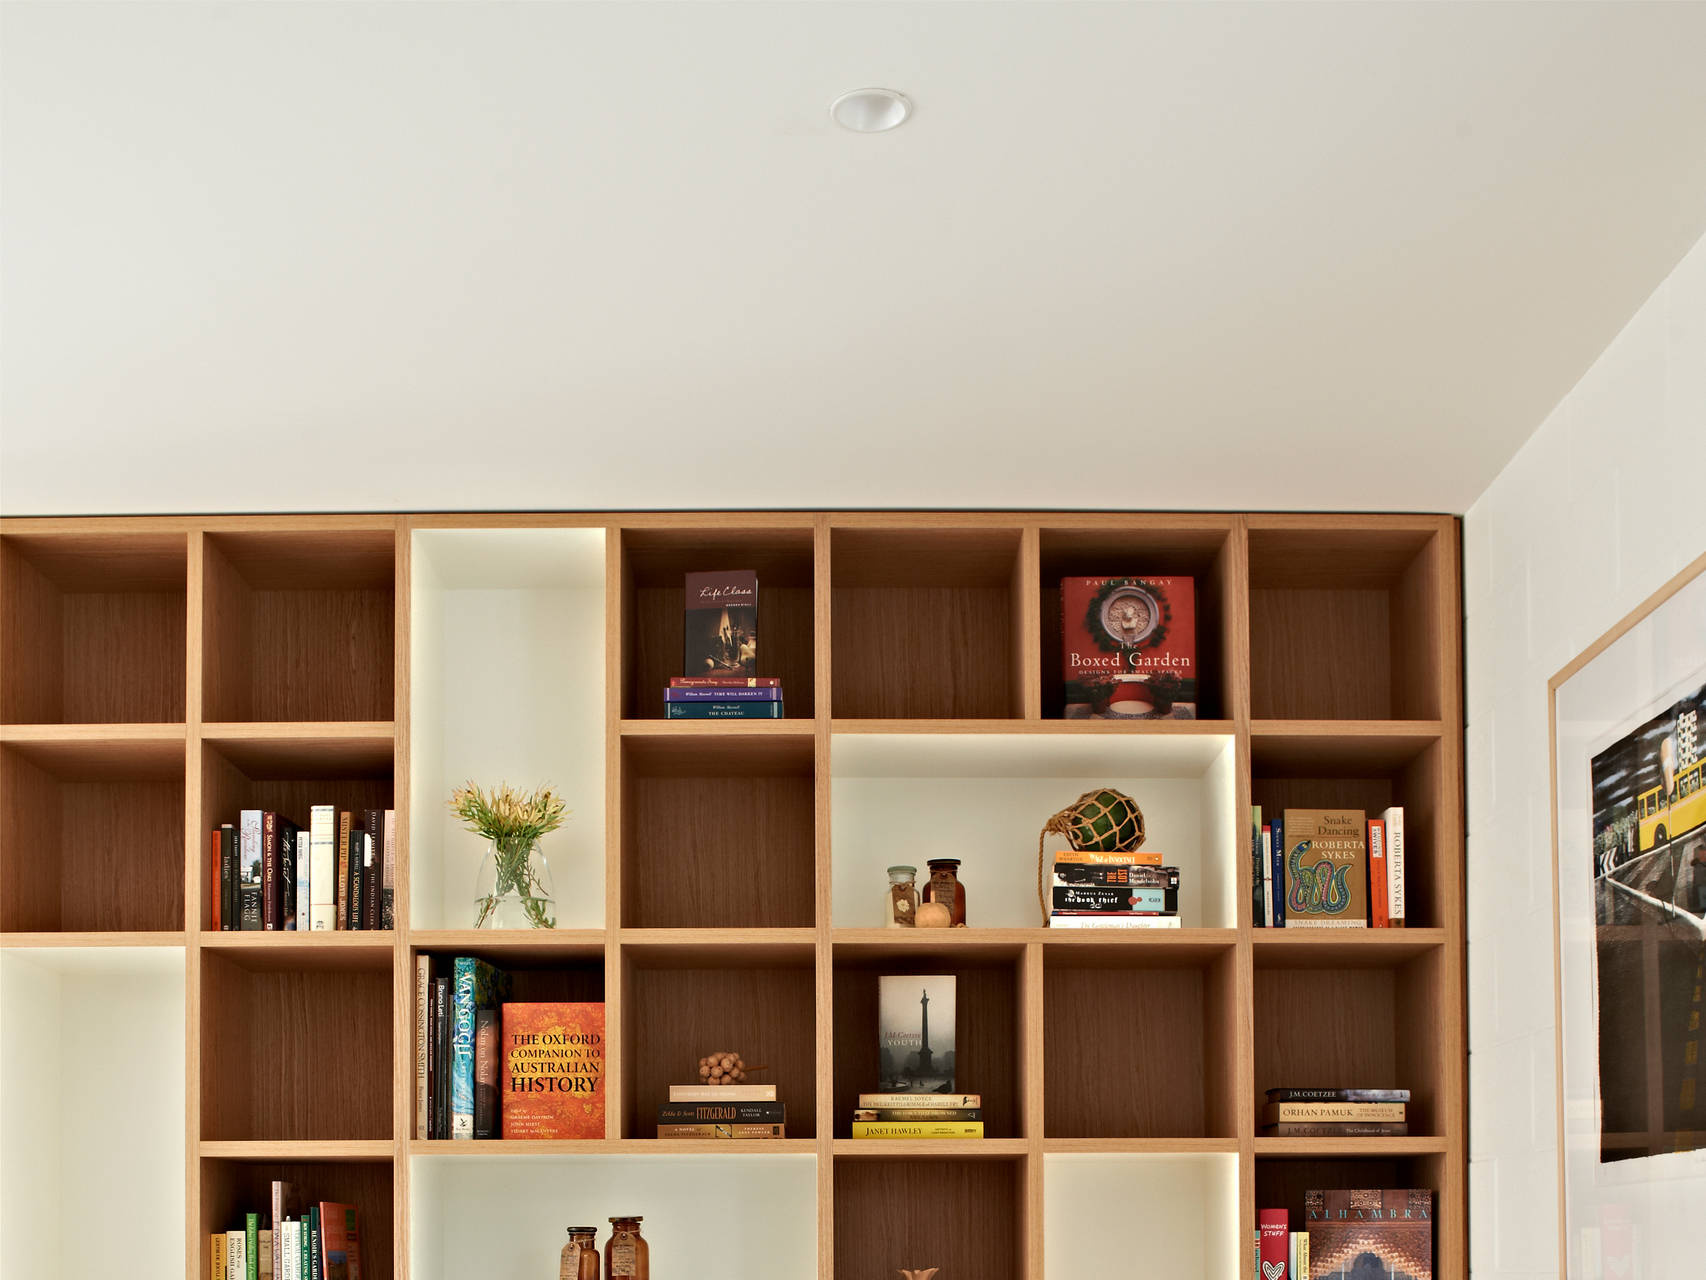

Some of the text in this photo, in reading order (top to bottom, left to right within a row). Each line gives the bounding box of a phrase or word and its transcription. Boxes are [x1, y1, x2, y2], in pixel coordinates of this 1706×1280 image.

[700, 586, 752, 600] Life Class
[1070, 652, 1191, 667] Boxed Garden
[1324, 816, 1353, 825] Snake
[1318, 826, 1360, 838] Dancing
[1312, 841, 1365, 849] ROBERTA
[1321, 850, 1355, 859] SYKES
[1394, 832, 1402, 881] ROBERTA
[417, 967, 425, 997] GRACE
[458, 974, 471, 1003] VAN
[437, 984, 445, 1004] Bruno
[479, 1020, 489, 1046] Nolan
[512, 1034, 600, 1045] THE OXFORD
[479, 1047, 487, 1058] on
[511, 1049, 600, 1058] COMPANION TO
[417, 1052, 425, 1079] SMITH
[479, 1060, 488, 1085] Nolan
[511, 1062, 600, 1073] AUSTRALIAN
[511, 1077, 598, 1092] HISTORY
[696, 1106, 736, 1120] FITZGERALD
[865, 1127, 922, 1137] JANET HAWLEY
[1310, 1209, 1427, 1219] ALHAMBRA
